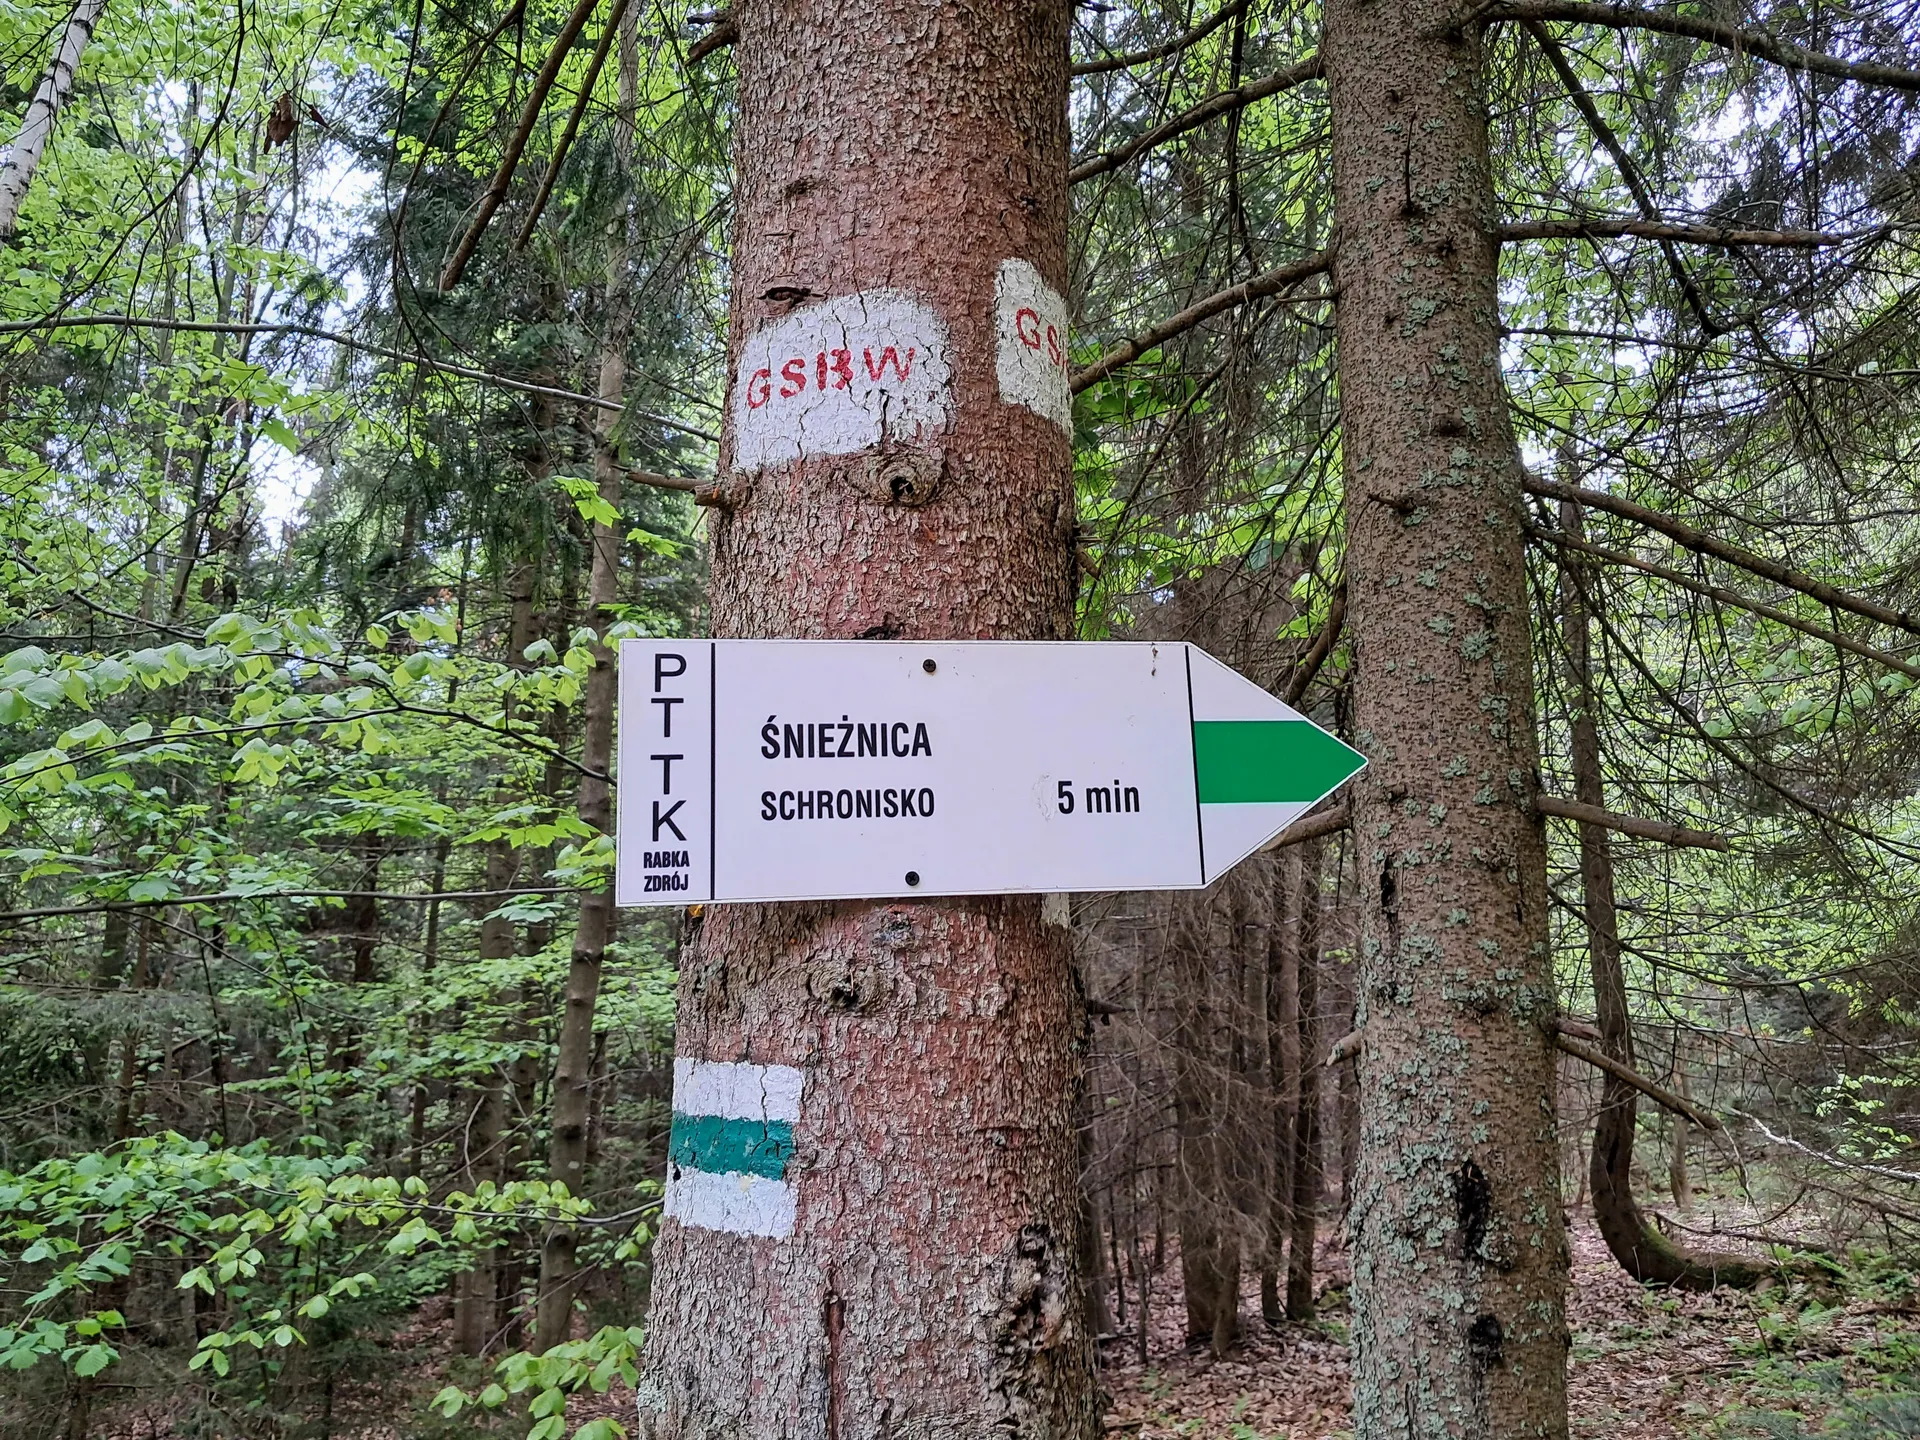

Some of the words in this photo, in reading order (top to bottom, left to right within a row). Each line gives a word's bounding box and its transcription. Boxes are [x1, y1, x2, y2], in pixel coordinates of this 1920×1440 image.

[1016, 307, 1067, 371] GS
[651, 653, 687, 843] PTTK
[761, 714, 932, 759] ŚNIEŻNICA
[761, 788, 934, 821] SCHRONISKO
[1057, 780, 1075, 815] 5
[1086, 779, 1140, 814] min
[643, 850, 690, 869] RABKA
[643, 871, 689, 892] ZDRÓJ
